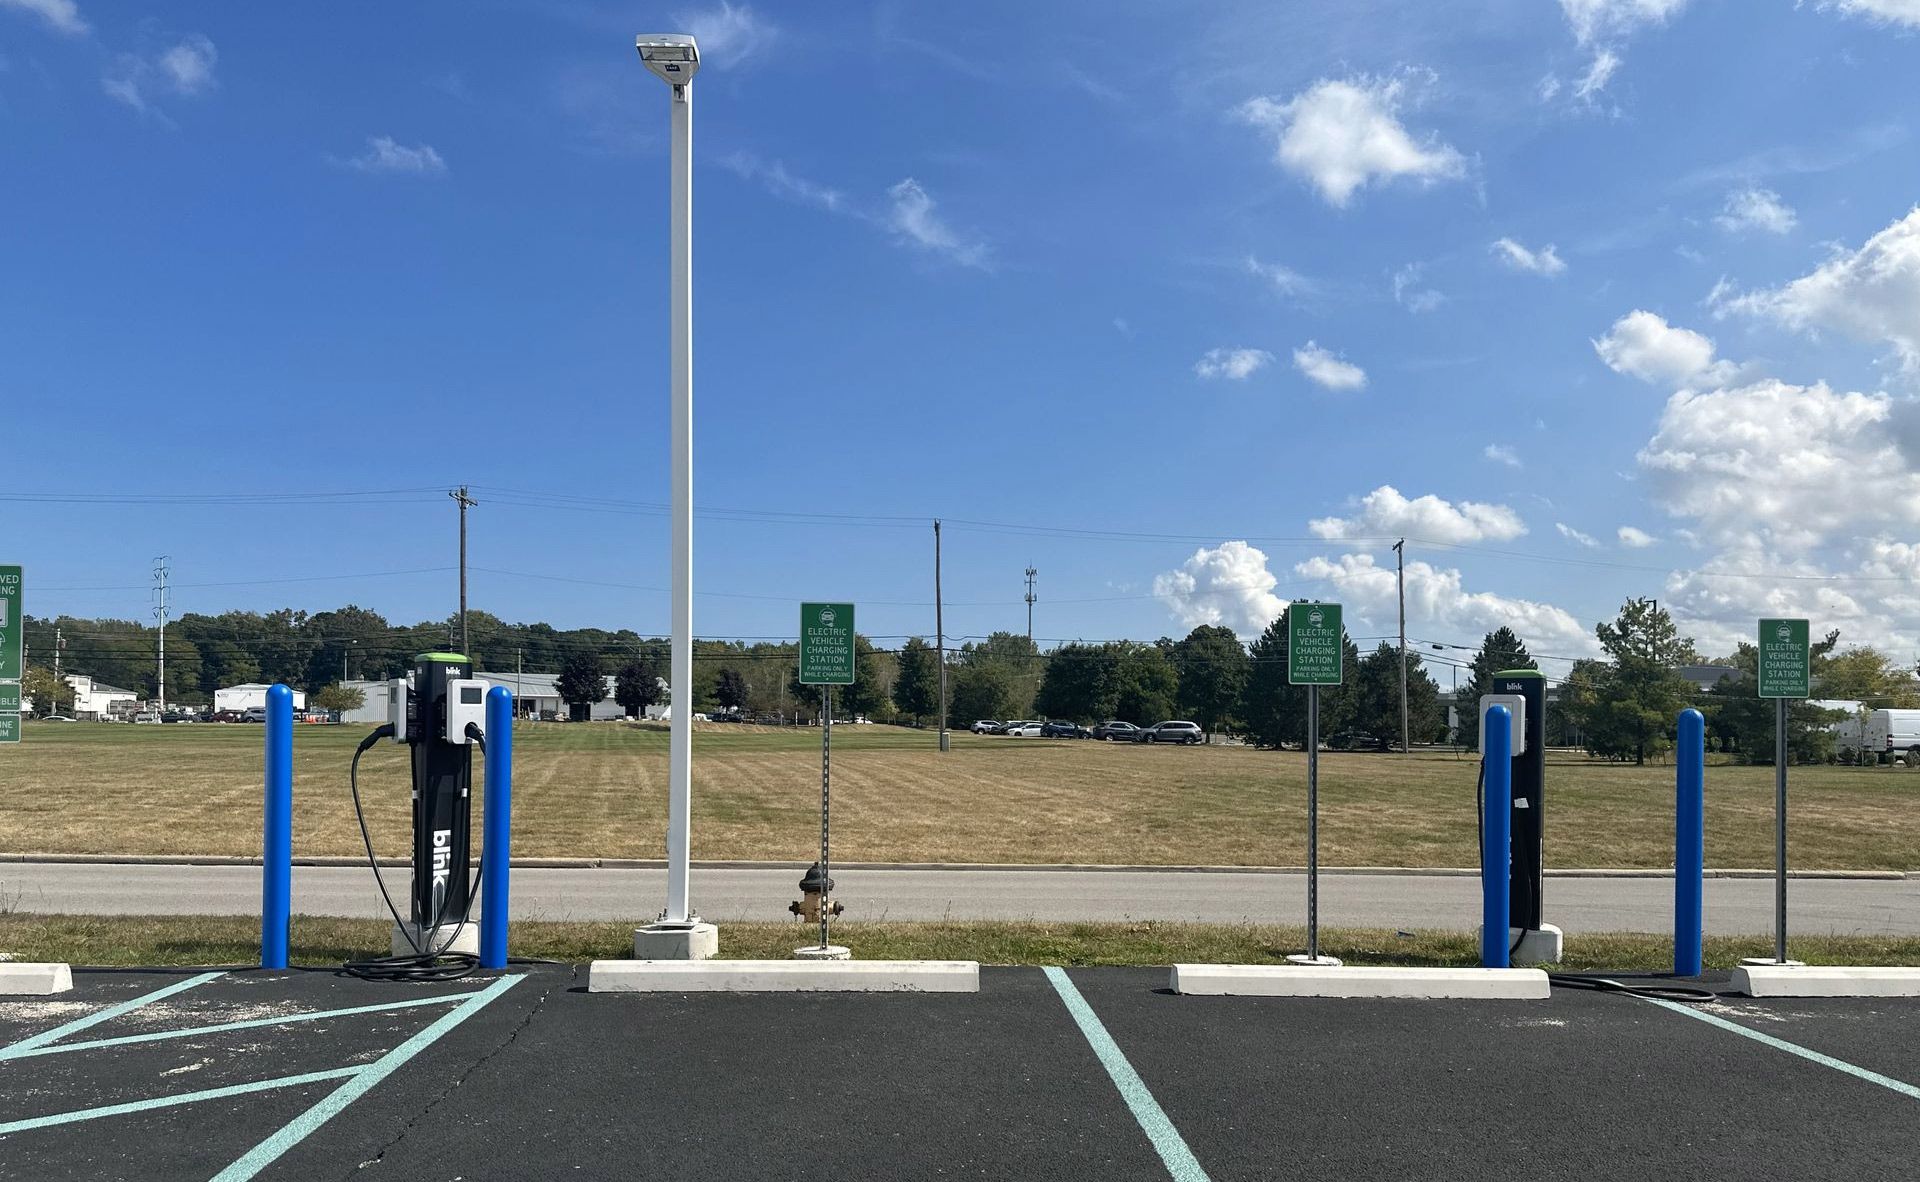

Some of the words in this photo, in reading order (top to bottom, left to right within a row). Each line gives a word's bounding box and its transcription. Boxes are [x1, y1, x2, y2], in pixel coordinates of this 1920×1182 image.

[808, 628, 847, 636] ELECTRIC
[810, 656, 844, 664] STATION
[446, 666, 460, 674] blink
[433, 830, 451, 888] blink
